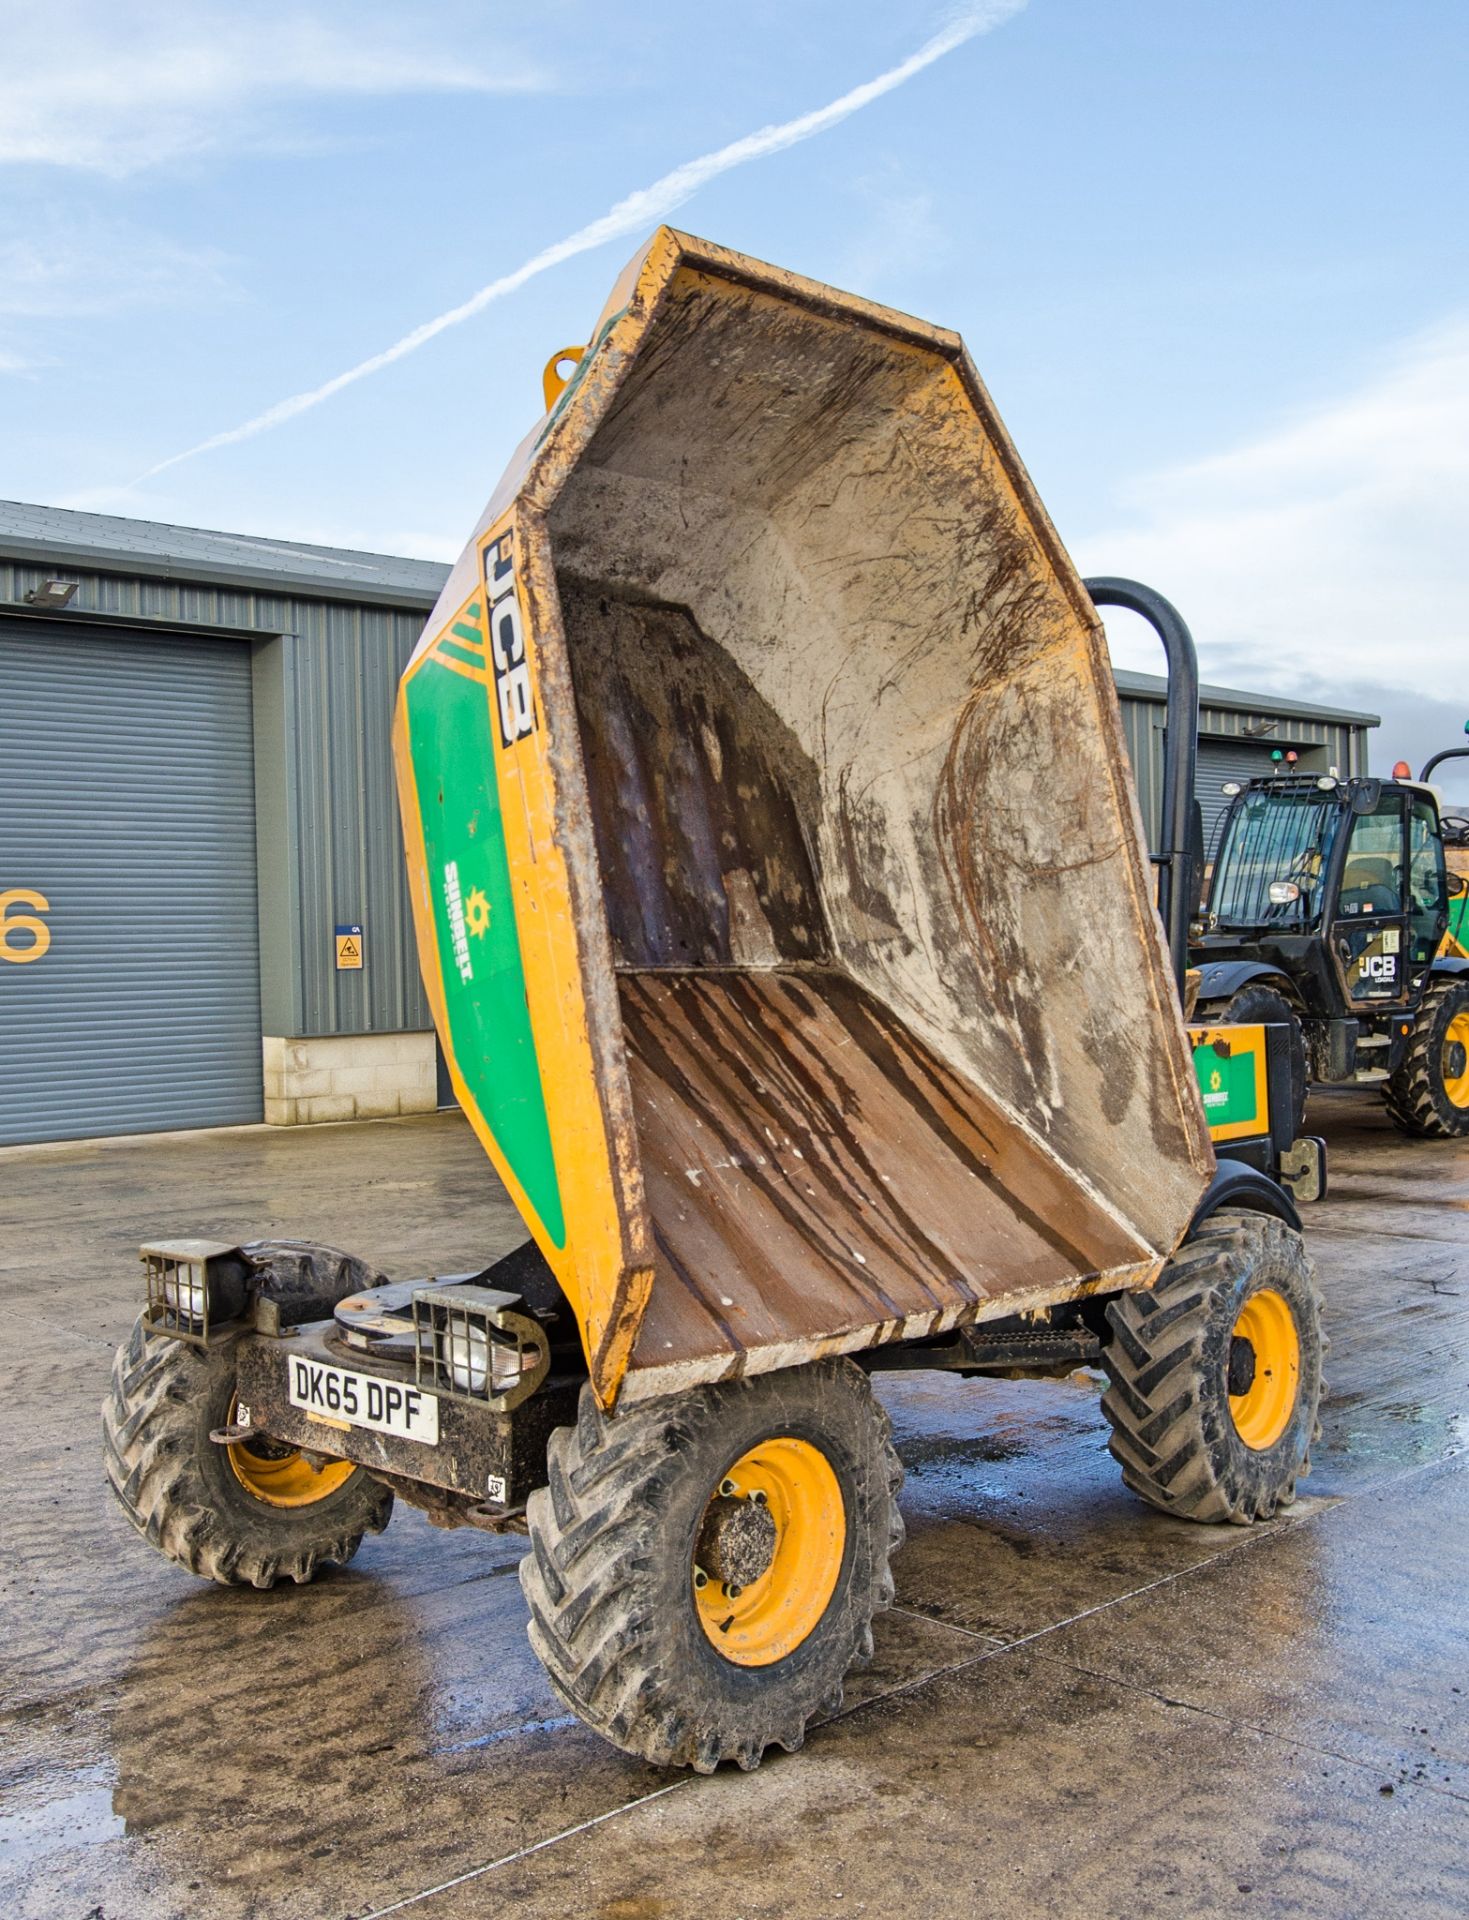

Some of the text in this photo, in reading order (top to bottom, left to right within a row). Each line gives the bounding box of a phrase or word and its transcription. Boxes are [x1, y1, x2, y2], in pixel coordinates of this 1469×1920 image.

[484, 534, 533, 742] JCB
[0, 888, 51, 964] 6
[444, 861, 474, 986] SUNBELT
[1358, 955, 1396, 978] JCB
[296, 1362, 422, 1430] DK65 DPF
